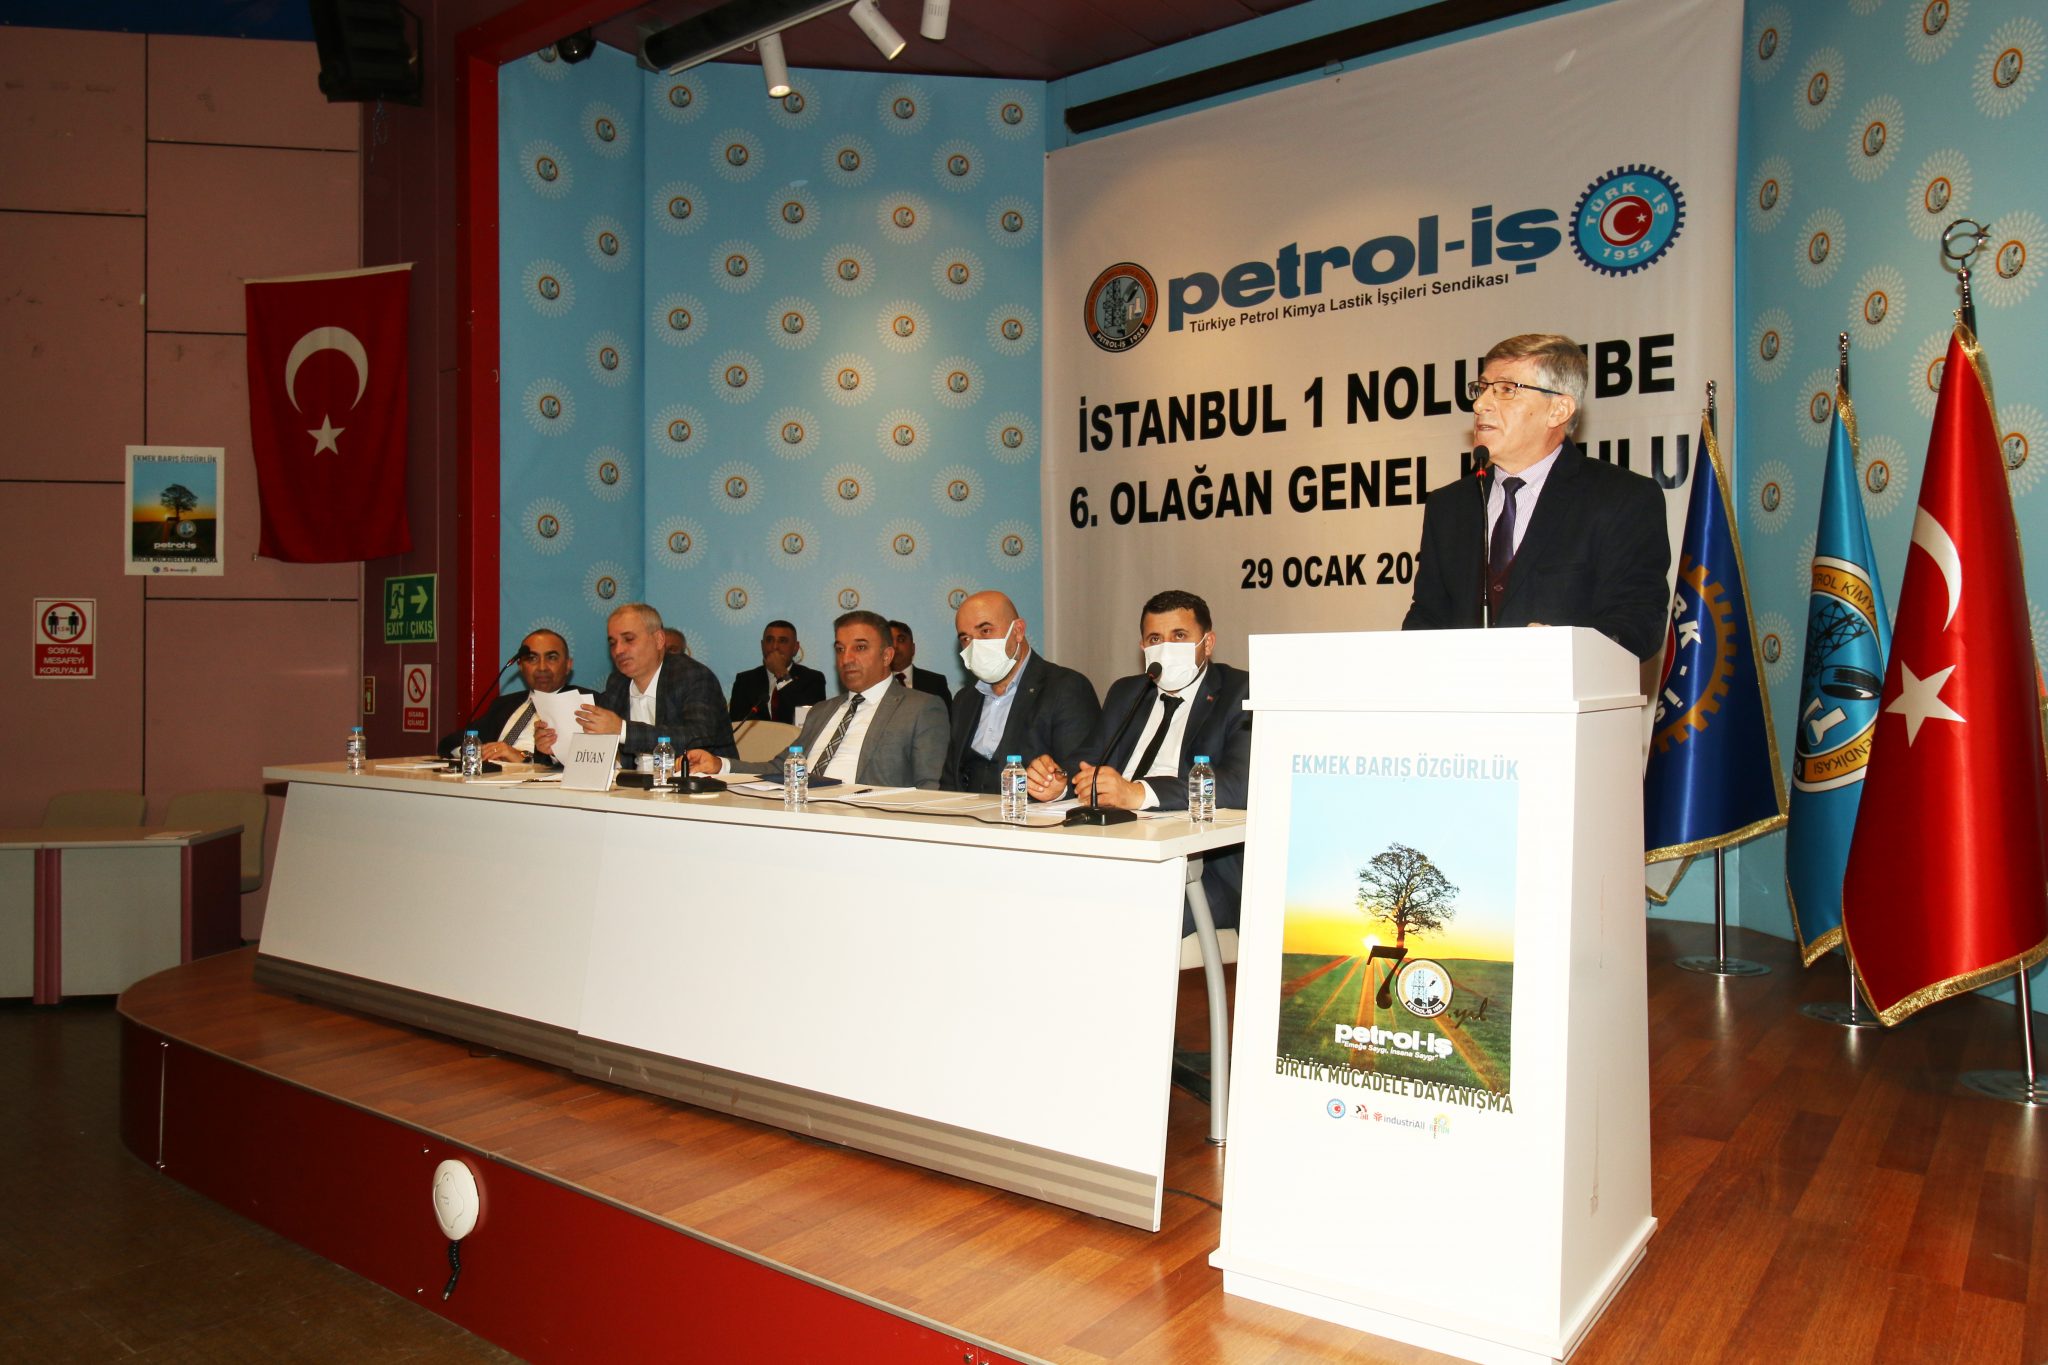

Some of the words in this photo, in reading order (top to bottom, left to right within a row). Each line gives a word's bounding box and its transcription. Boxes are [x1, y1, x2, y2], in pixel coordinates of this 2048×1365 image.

[1168, 205, 1562, 333] petrol-iş
[1602, 240, 1654, 261] 1952
[1189, 316, 1236, 334] Türkiye
[1240, 307, 1279, 326] Petrol
[1283, 302, 1326, 319] Kimya
[1330, 293, 1373, 311] Lastik
[1377, 283, 1427, 307] İşçileri
[1431, 273, 1509, 296] Sendikası
[1079, 383, 1287, 453] İSTANBUL
[1304, 376, 1323, 428] 1
[1347, 356, 1486, 425] NOLU
[1578, 333, 1675, 399] BE
[1069, 486, 1098, 529] 6.
[1109, 464, 1272, 526] OLAĞAN
[1288, 455, 1432, 514] GENEL
[1241, 558, 1273, 589] 29
[1282, 554, 1367, 588] OCAK
[1376, 551, 1421, 585] 20
[386, 622, 404, 636] EXIT
[47, 646, 81, 655] SOSYAL
[39, 666, 89, 674] KORUYALIM
[575, 749, 606, 764] DİVAN
[1291, 754, 1350, 775] EKMEK
[1355, 756, 1412, 783] BARIŞ
[1416, 752, 1519, 781] ÖZGÜRLÜK
[1334, 1023, 1454, 1060] petrol-iş
[1275, 1053, 1325, 1082] BİRLİK
[1328, 1062, 1410, 1097] MÜCADELE
[1413, 1078, 1514, 1115] DAYANIŞMA
